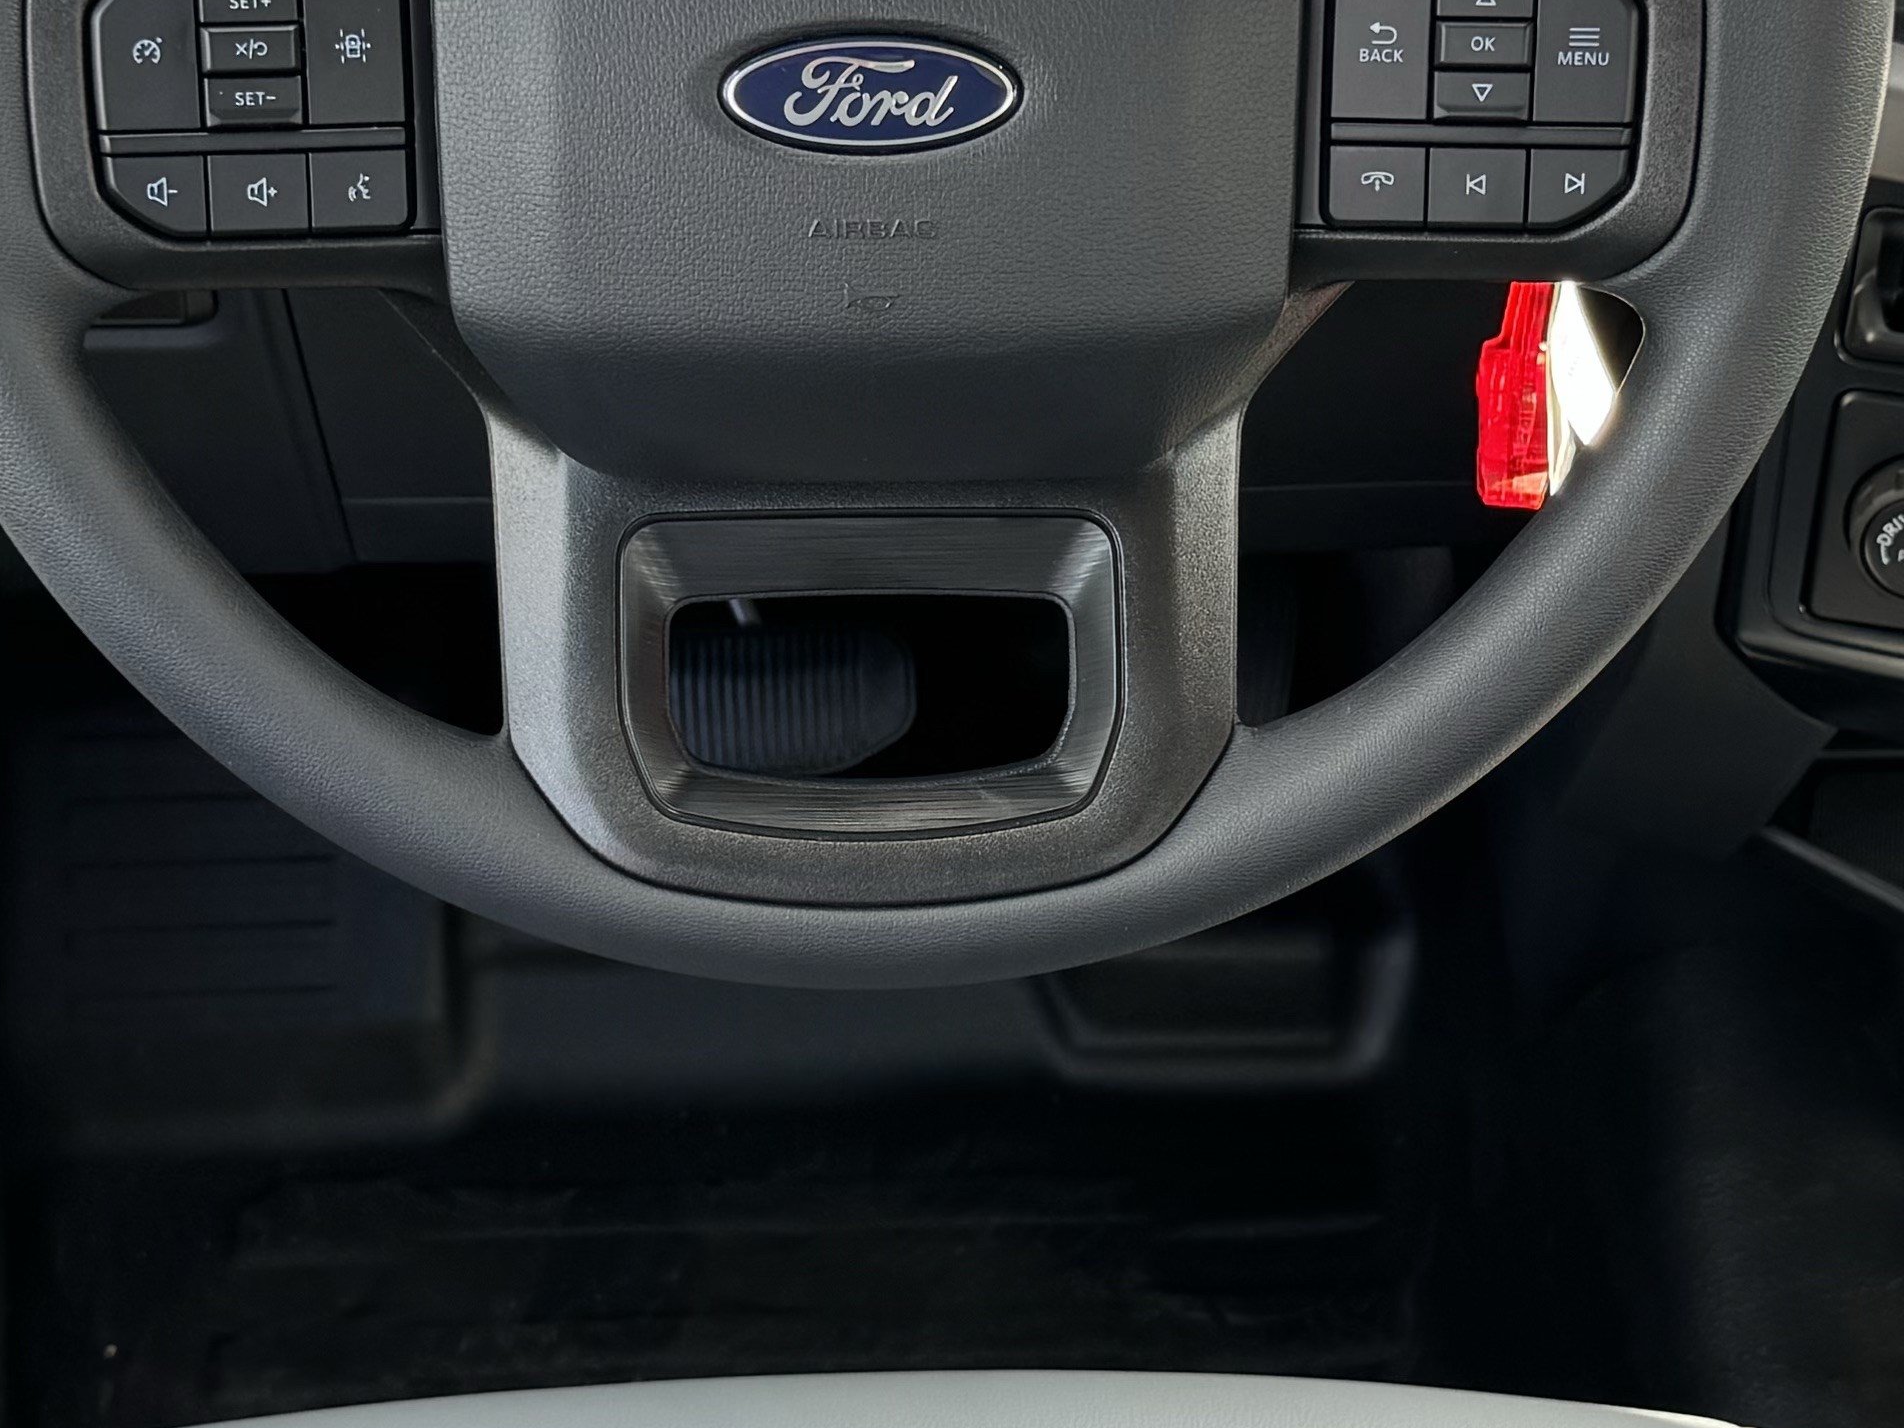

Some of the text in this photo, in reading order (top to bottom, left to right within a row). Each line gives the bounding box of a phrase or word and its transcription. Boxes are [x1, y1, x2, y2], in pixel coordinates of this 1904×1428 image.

[1470, 36, 1496, 52] OK
[1359, 48, 1404, 64] BACK
[1557, 51, 1610, 67] MENU
[784, 56, 958, 127] Ford
[808, 219, 938, 240] AIRBAG
